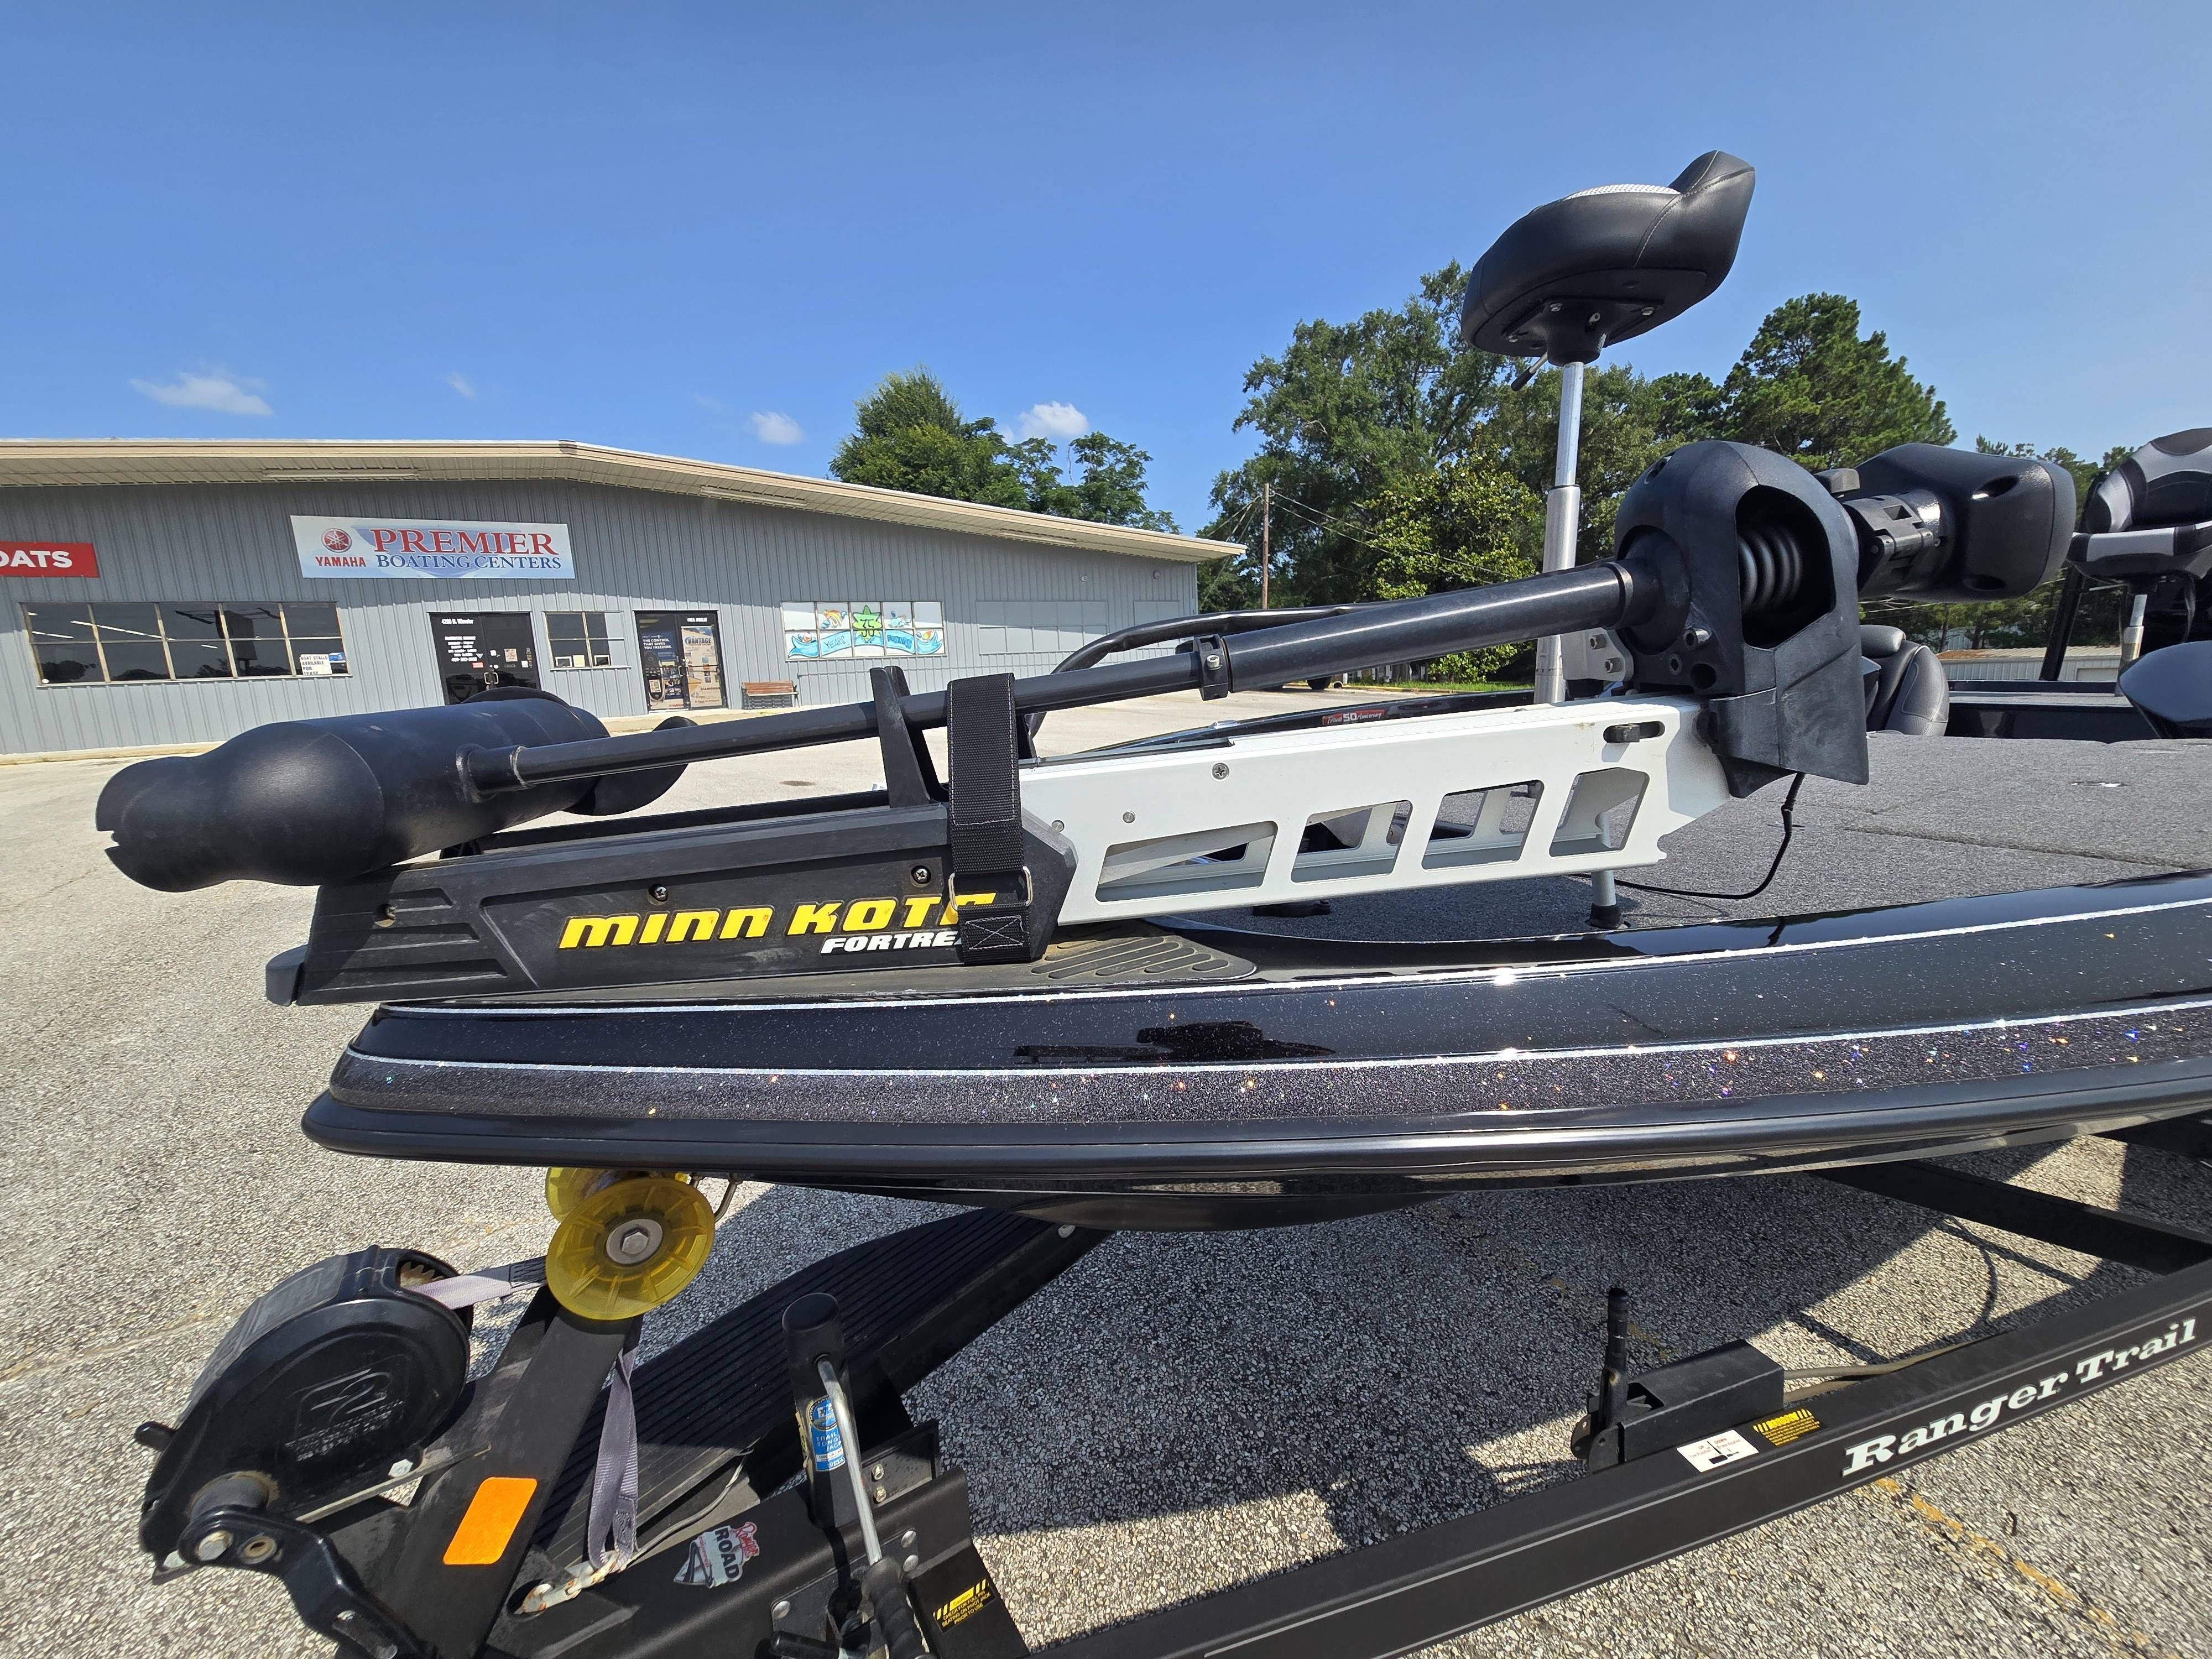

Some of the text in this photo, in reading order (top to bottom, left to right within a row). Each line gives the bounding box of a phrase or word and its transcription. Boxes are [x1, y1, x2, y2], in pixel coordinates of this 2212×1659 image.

[370, 529, 559, 555] PREMIER
[0, 550, 72, 568] OATS
[315, 556, 367, 567] YAMAHA
[375, 555, 561, 568] BOATING CENTERS
[824, 635, 912, 649] YEARS BUSINESS
[1343, 713, 1357, 722] 50
[820, 931, 962, 954] FORTRE
[1841, 1317, 2197, 1477] Ranger Trail
[817, 1432, 837, 1441] TRAIL
[818, 1436, 841, 1447] TONG
[715, 1527, 739, 1578] ROAD
[943, 1608, 958, 1620] CHECK
[958, 1601, 967, 1610] FOR
[967, 1595, 978, 1605] FULL
[953, 1593, 971, 1606] Caution
[967, 1599, 979, 1610] PIVOT
[980, 1592, 991, 1602] JACK
[954, 1613, 968, 1625] PRIOR
[974, 1603, 984, 1611] USE
